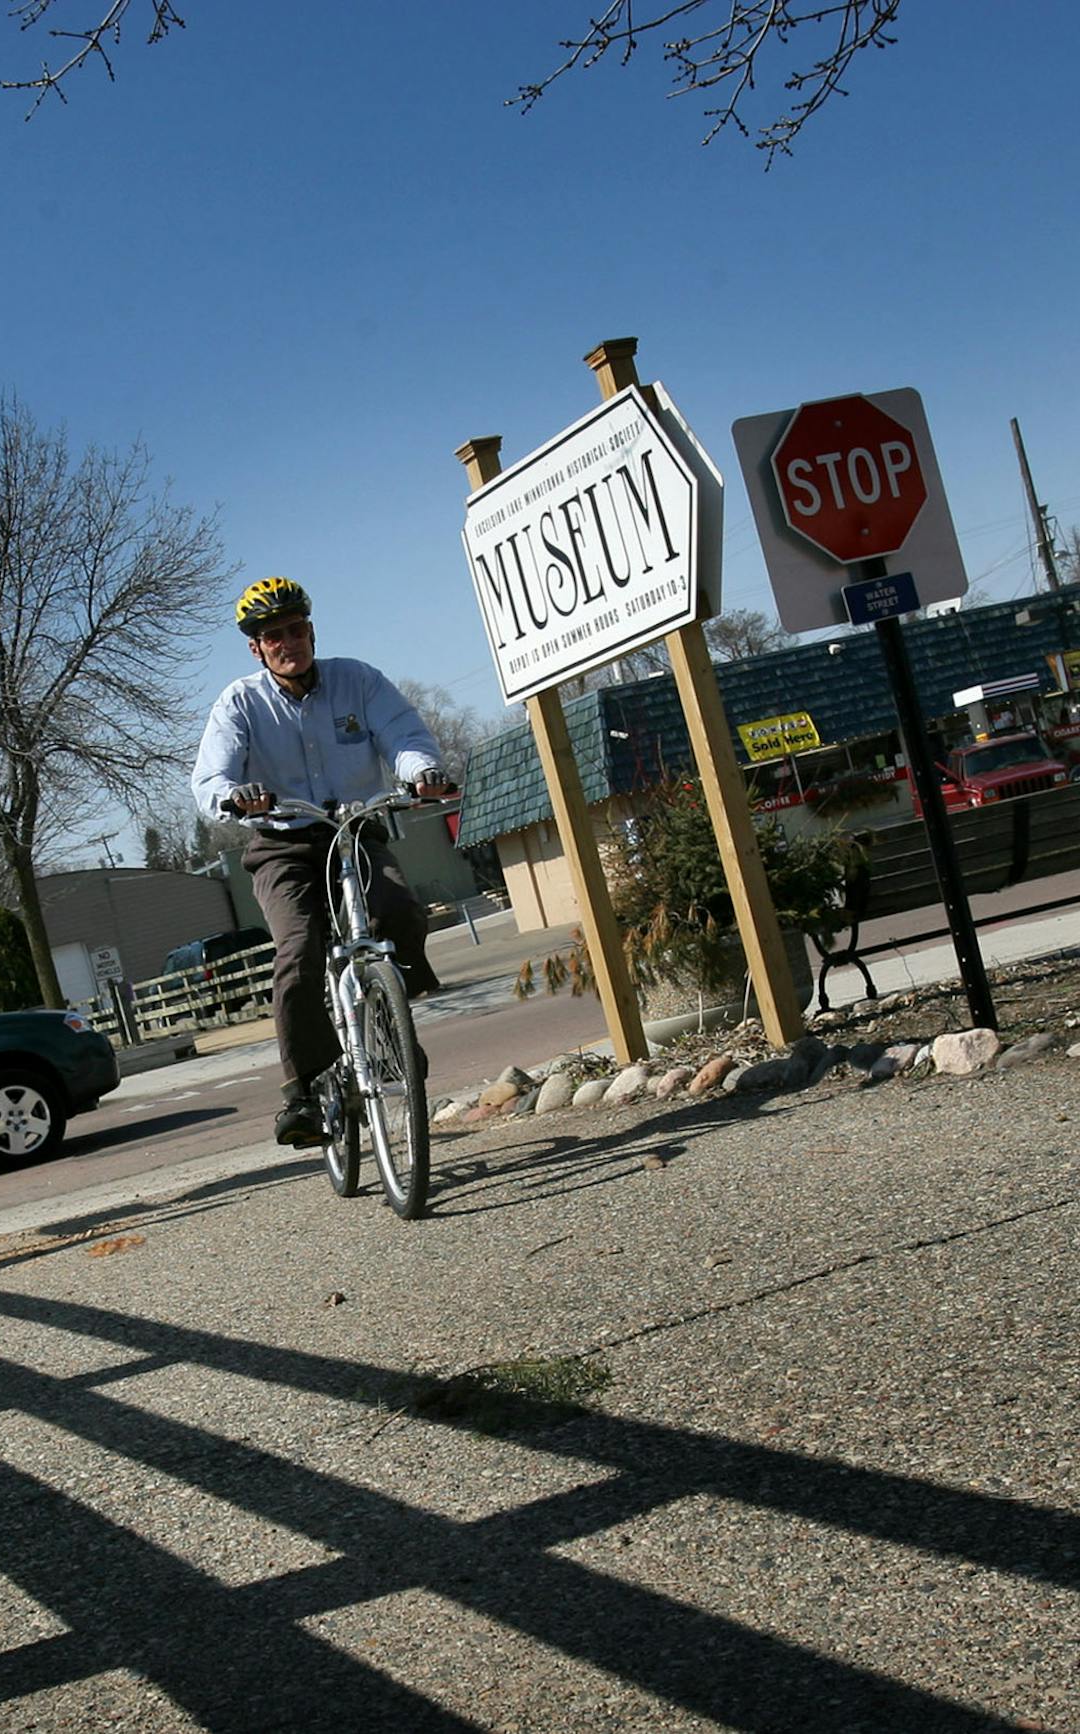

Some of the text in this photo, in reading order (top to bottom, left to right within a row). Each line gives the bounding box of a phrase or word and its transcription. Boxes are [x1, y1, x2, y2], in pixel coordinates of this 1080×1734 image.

[507, 496, 524, 518] LAKE
[524, 470, 565, 506] MINNETONKA
[567, 442, 609, 479] HISTORICAL
[608, 421, 642, 451] SOCIETY
[787, 441, 912, 516] STOP
[475, 449, 680, 650] MUSEUM
[865, 586, 897, 601] WATER
[867, 596, 899, 611] STREET
[509, 575, 687, 675] DEPOT IS OPEN SUMMER HOURS SATURDAY 10-3
[752, 732, 813, 752] Sold Here
[98, 951, 111, 960] NO
